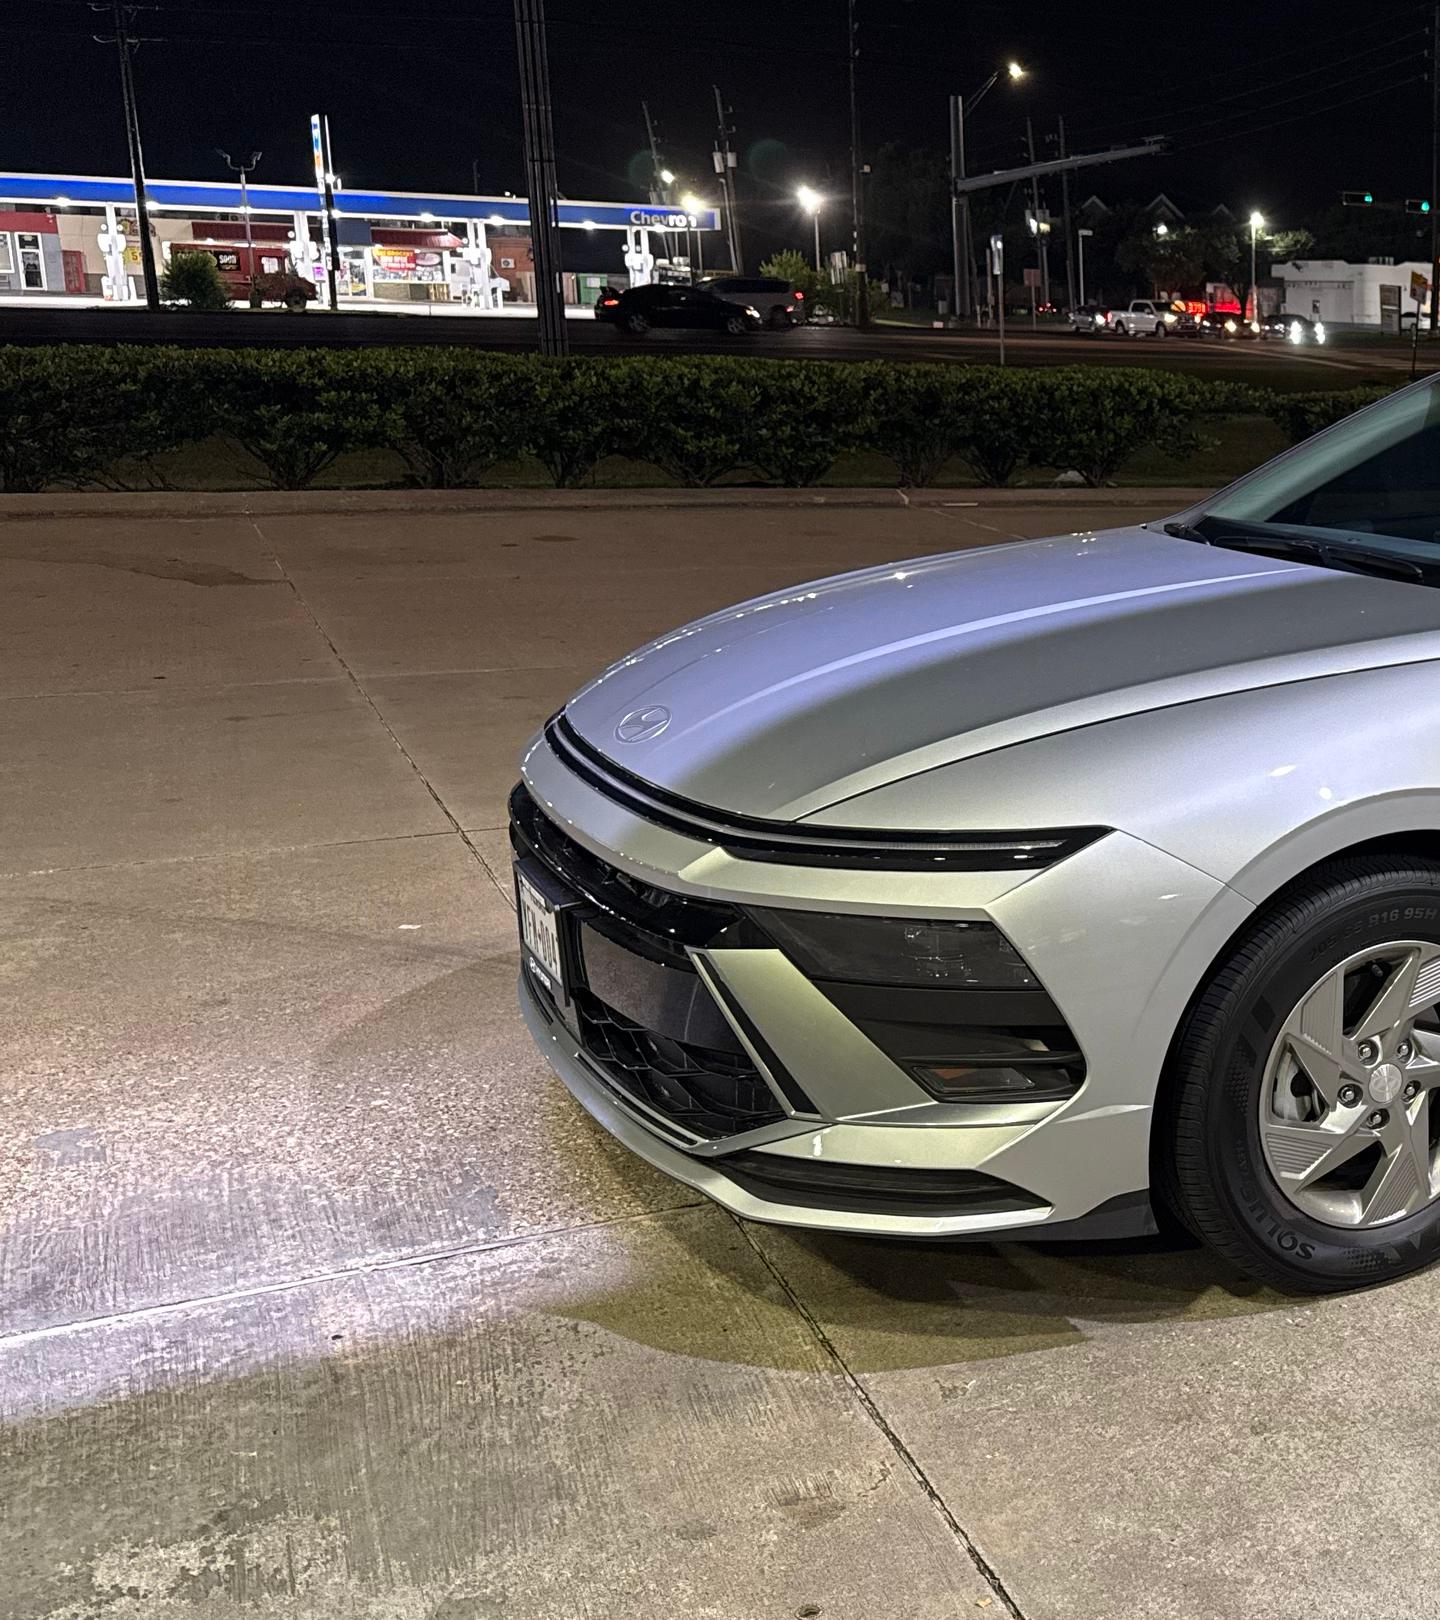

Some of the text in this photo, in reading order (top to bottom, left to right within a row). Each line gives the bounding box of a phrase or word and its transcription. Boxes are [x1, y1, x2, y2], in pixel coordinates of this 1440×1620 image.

[630, 211, 697, 227] Chevron
[1368, 908, 1400, 928] R16
[1403, 907, 1438, 921] 95H
